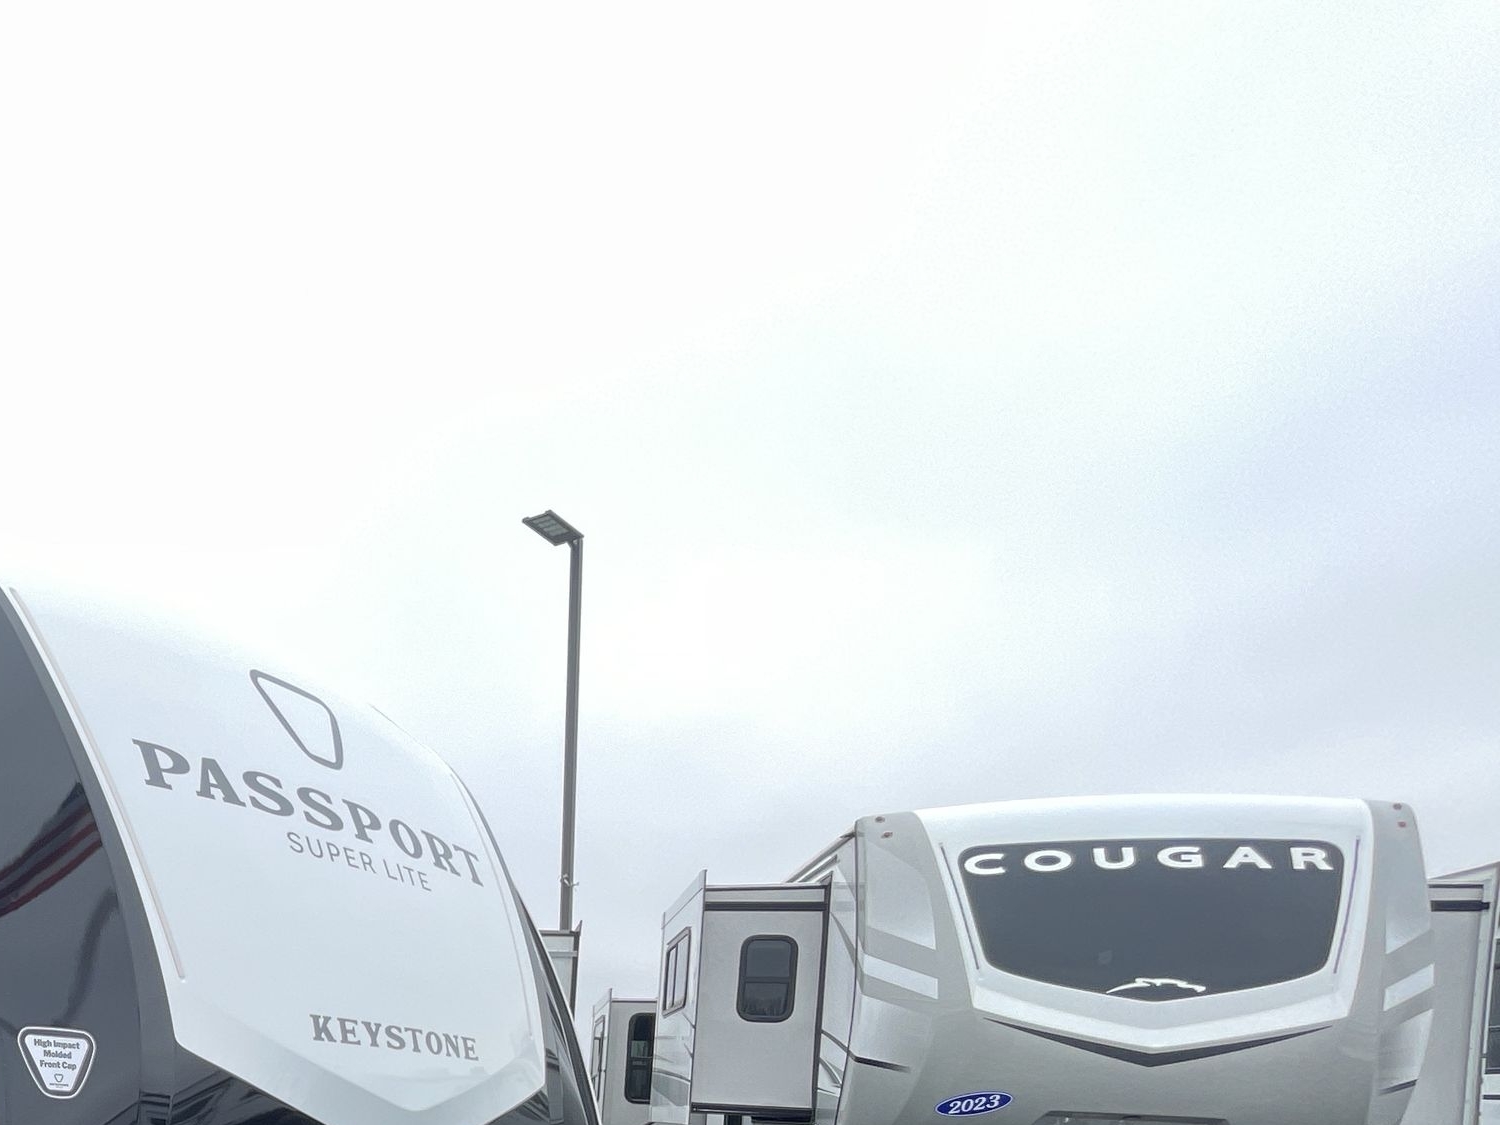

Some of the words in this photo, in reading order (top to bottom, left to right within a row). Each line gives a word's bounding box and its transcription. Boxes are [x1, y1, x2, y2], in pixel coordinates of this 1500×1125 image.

[131, 738, 484, 887] PASSPORT
[286, 831, 377, 874] SUPER
[383, 858, 432, 892] LITE
[963, 846, 1334, 876] COUGAR
[33, 1038, 52, 1049] High
[53, 1040, 81, 1050] Impact
[309, 1014, 479, 1061] KEYSTONE
[40, 1060, 61, 1069] Front
[62, 1062, 77, 1071] Cap
[43, 1050, 72, 1060] Molded
[948, 1095, 1001, 1114] 2023
